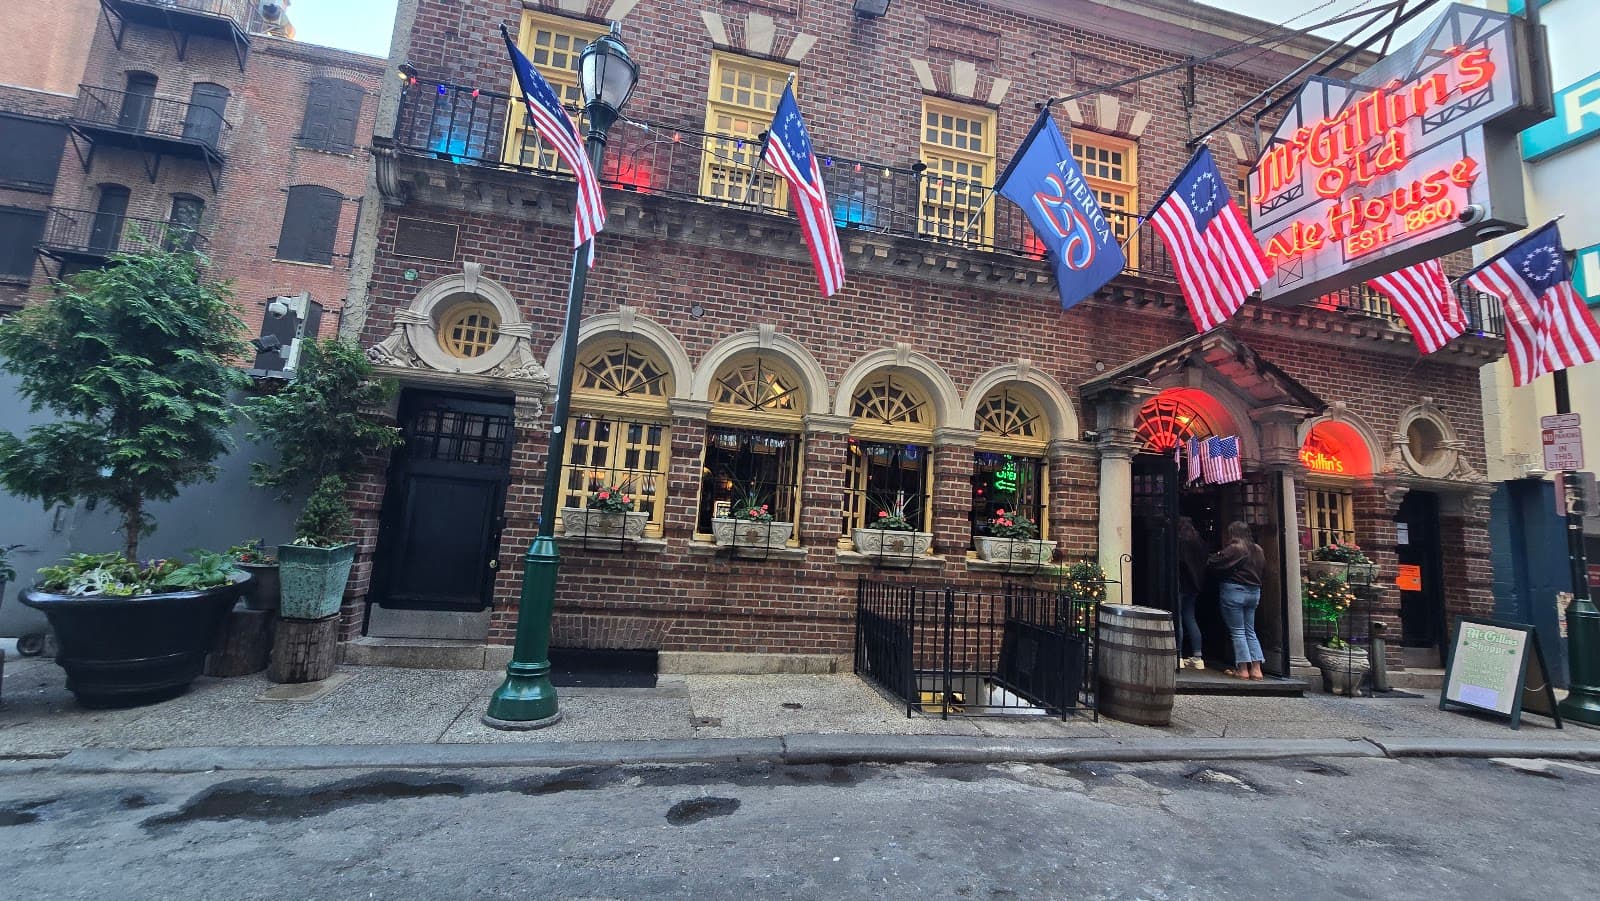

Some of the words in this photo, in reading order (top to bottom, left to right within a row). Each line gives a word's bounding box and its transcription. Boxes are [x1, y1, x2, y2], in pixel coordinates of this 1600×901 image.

[1315, 128, 1408, 199] Old
[1056, 159, 1110, 245] AMERICA
[1265, 220, 1325, 258] Ale
[1326, 156, 1480, 243] House
[1404, 198, 1453, 233] 1860
[1549, 461, 1578, 469] STREET
